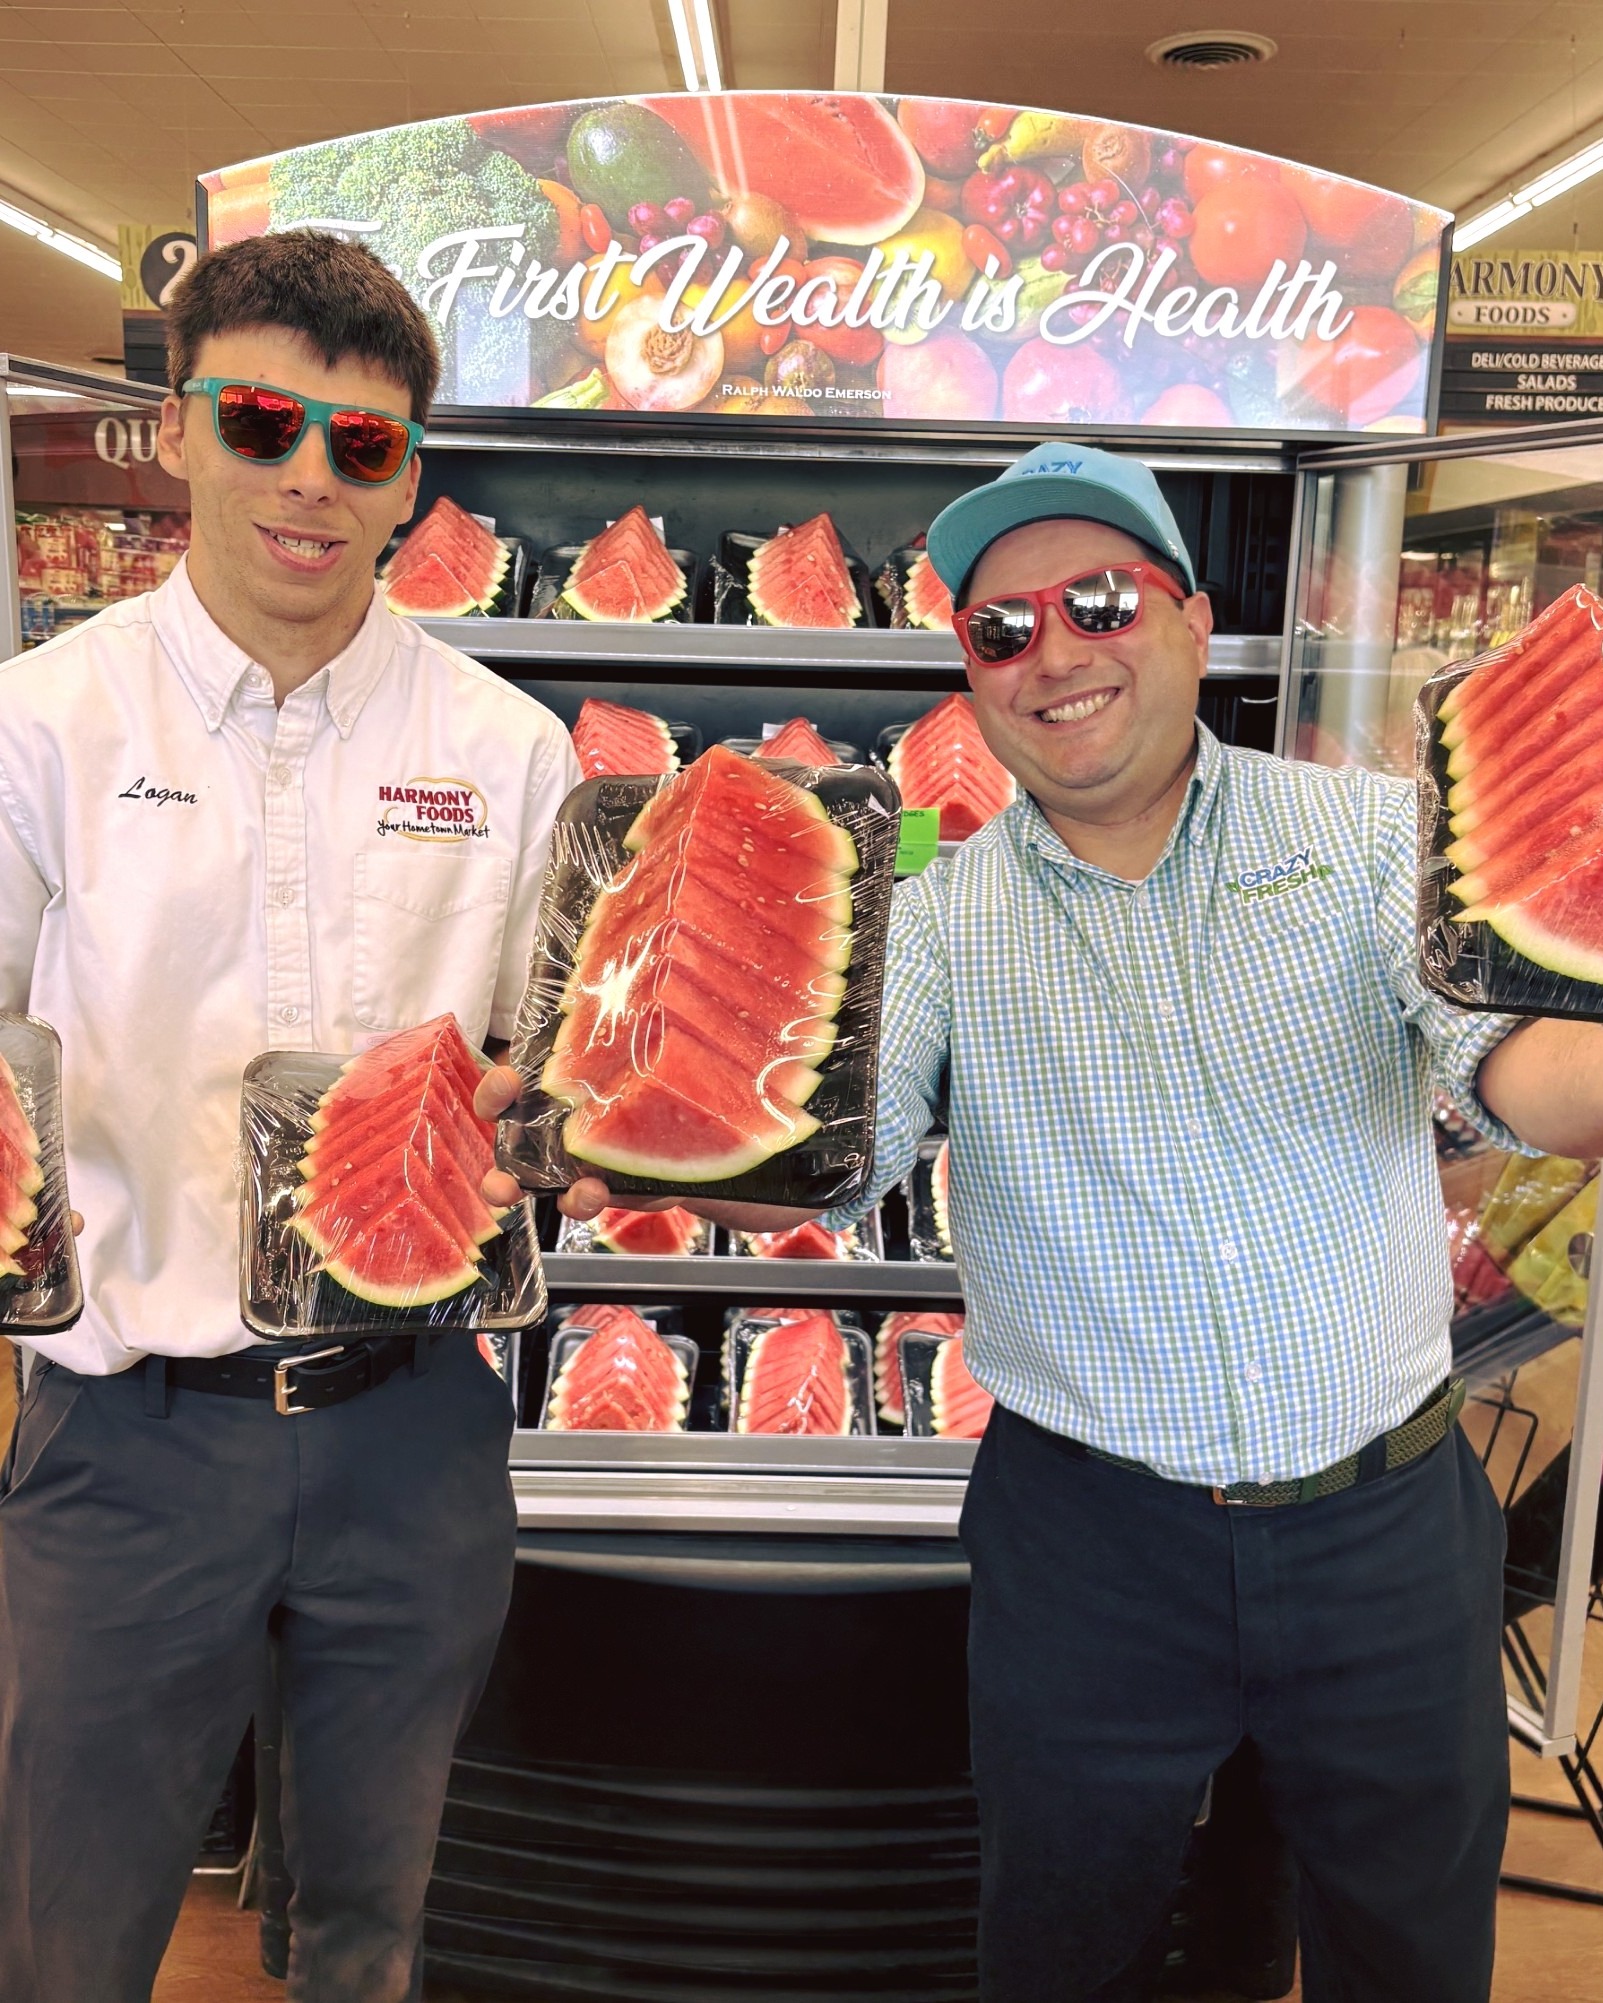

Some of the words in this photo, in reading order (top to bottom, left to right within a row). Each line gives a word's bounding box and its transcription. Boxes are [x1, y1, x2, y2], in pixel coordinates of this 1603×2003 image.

[417, 224, 638, 328] First
[630, 234, 953, 337] Wealth
[960, 253, 1025, 333] is
[1039, 242, 1355, 349] Health
[1450, 258, 1603, 303] ARMONY
[1474, 305, 1551, 325] FOODS
[1471, 352, 1539, 369] DELI/COLD
[722, 384, 768, 397] RALPH
[772, 386, 822, 398] WALDO
[825, 387, 892, 400] EMERSON
[1516, 374, 1578, 391] SALADS
[1485, 394, 1533, 411] FRESH
[1535, 395, 1603, 412] PRODUCE
[95, 416, 159, 469] QU
[118, 776, 198, 807] Logan
[378, 786, 473, 806] HARMONY
[416, 805, 474, 823] FOODS
[376, 819, 401, 836] Your
[402, 820, 452, 834] Hometown
[453, 823, 491, 838] Market
[1238, 846, 1312, 888] CRAZY
[1242, 862, 1319, 905] FRESH
